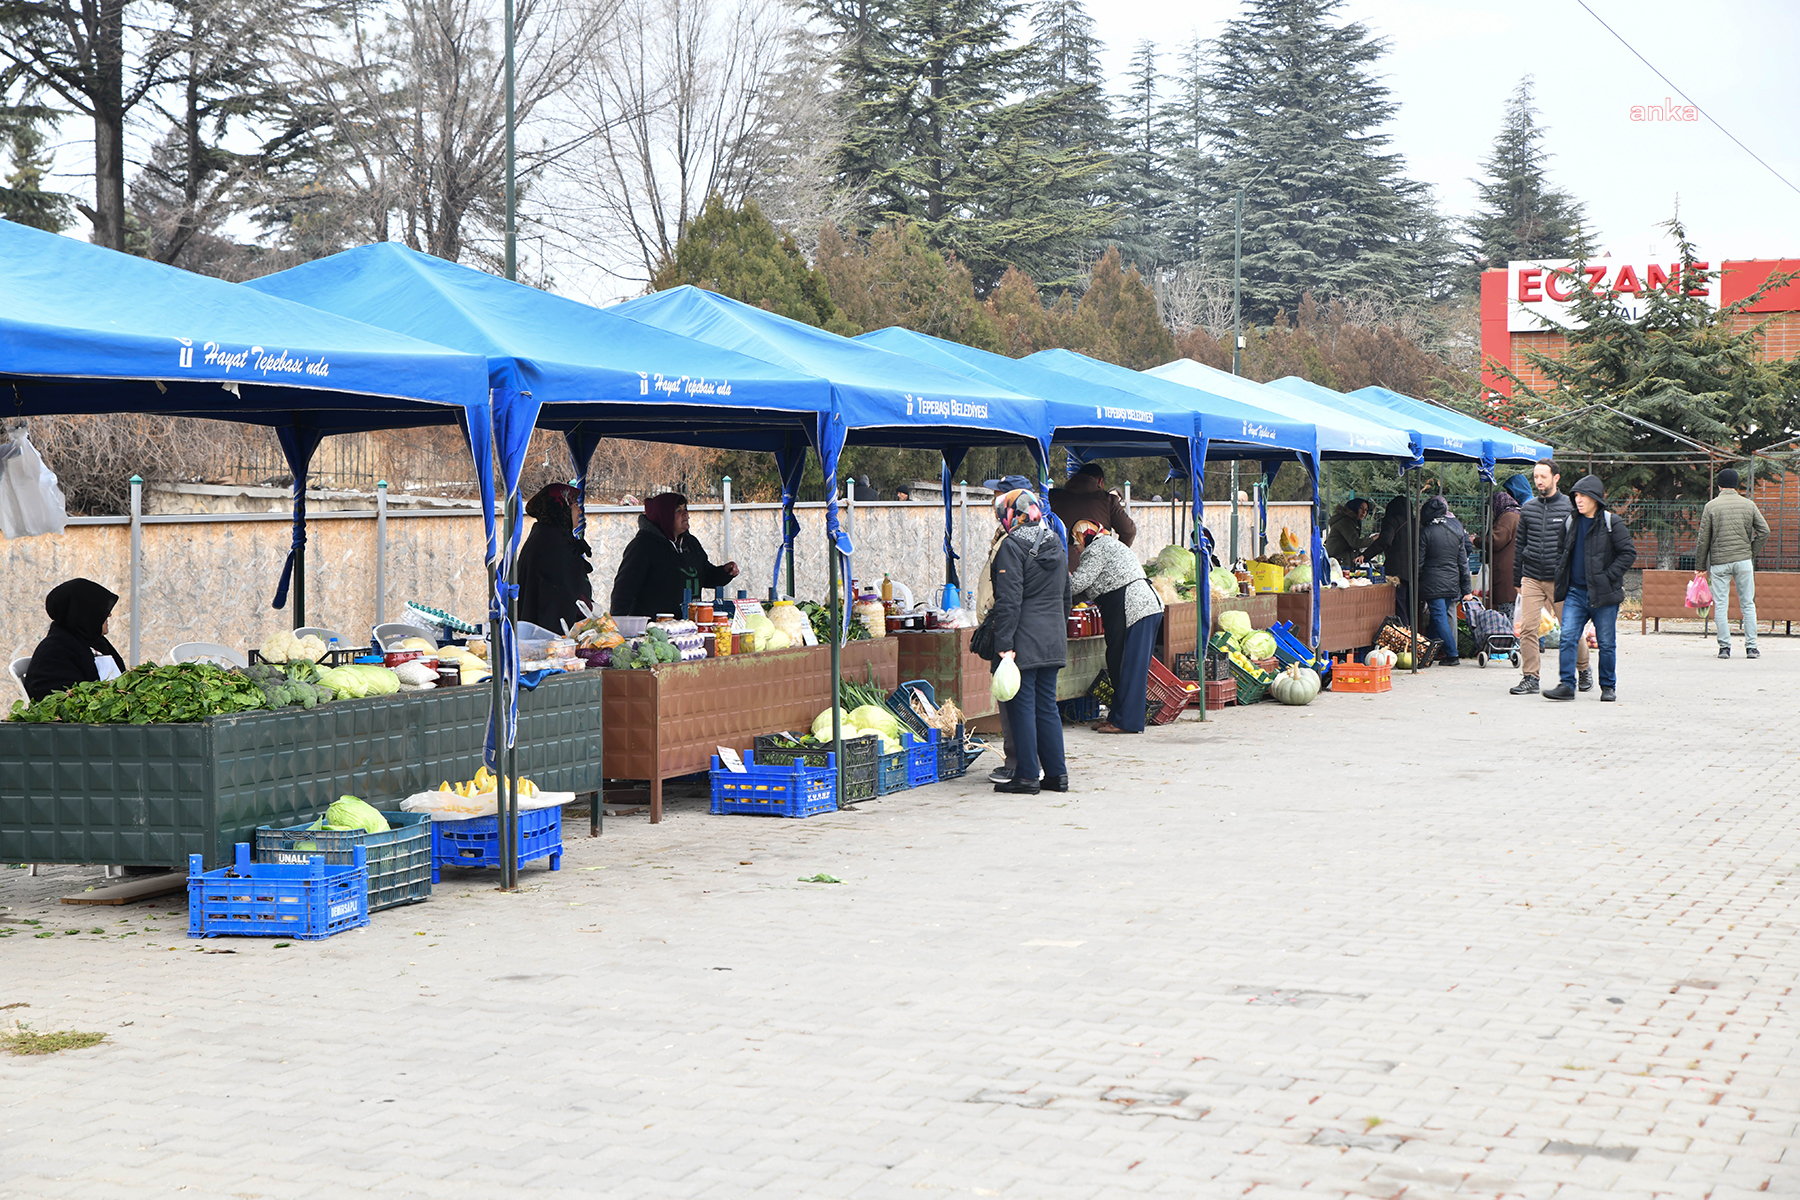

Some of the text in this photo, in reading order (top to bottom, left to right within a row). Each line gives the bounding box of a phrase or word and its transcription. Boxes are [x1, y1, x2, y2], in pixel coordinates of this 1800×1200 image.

[1518, 261, 1709, 302] ECZANE
[203, 341, 249, 373] Hayat
[653, 371, 681, 397] Hayat
